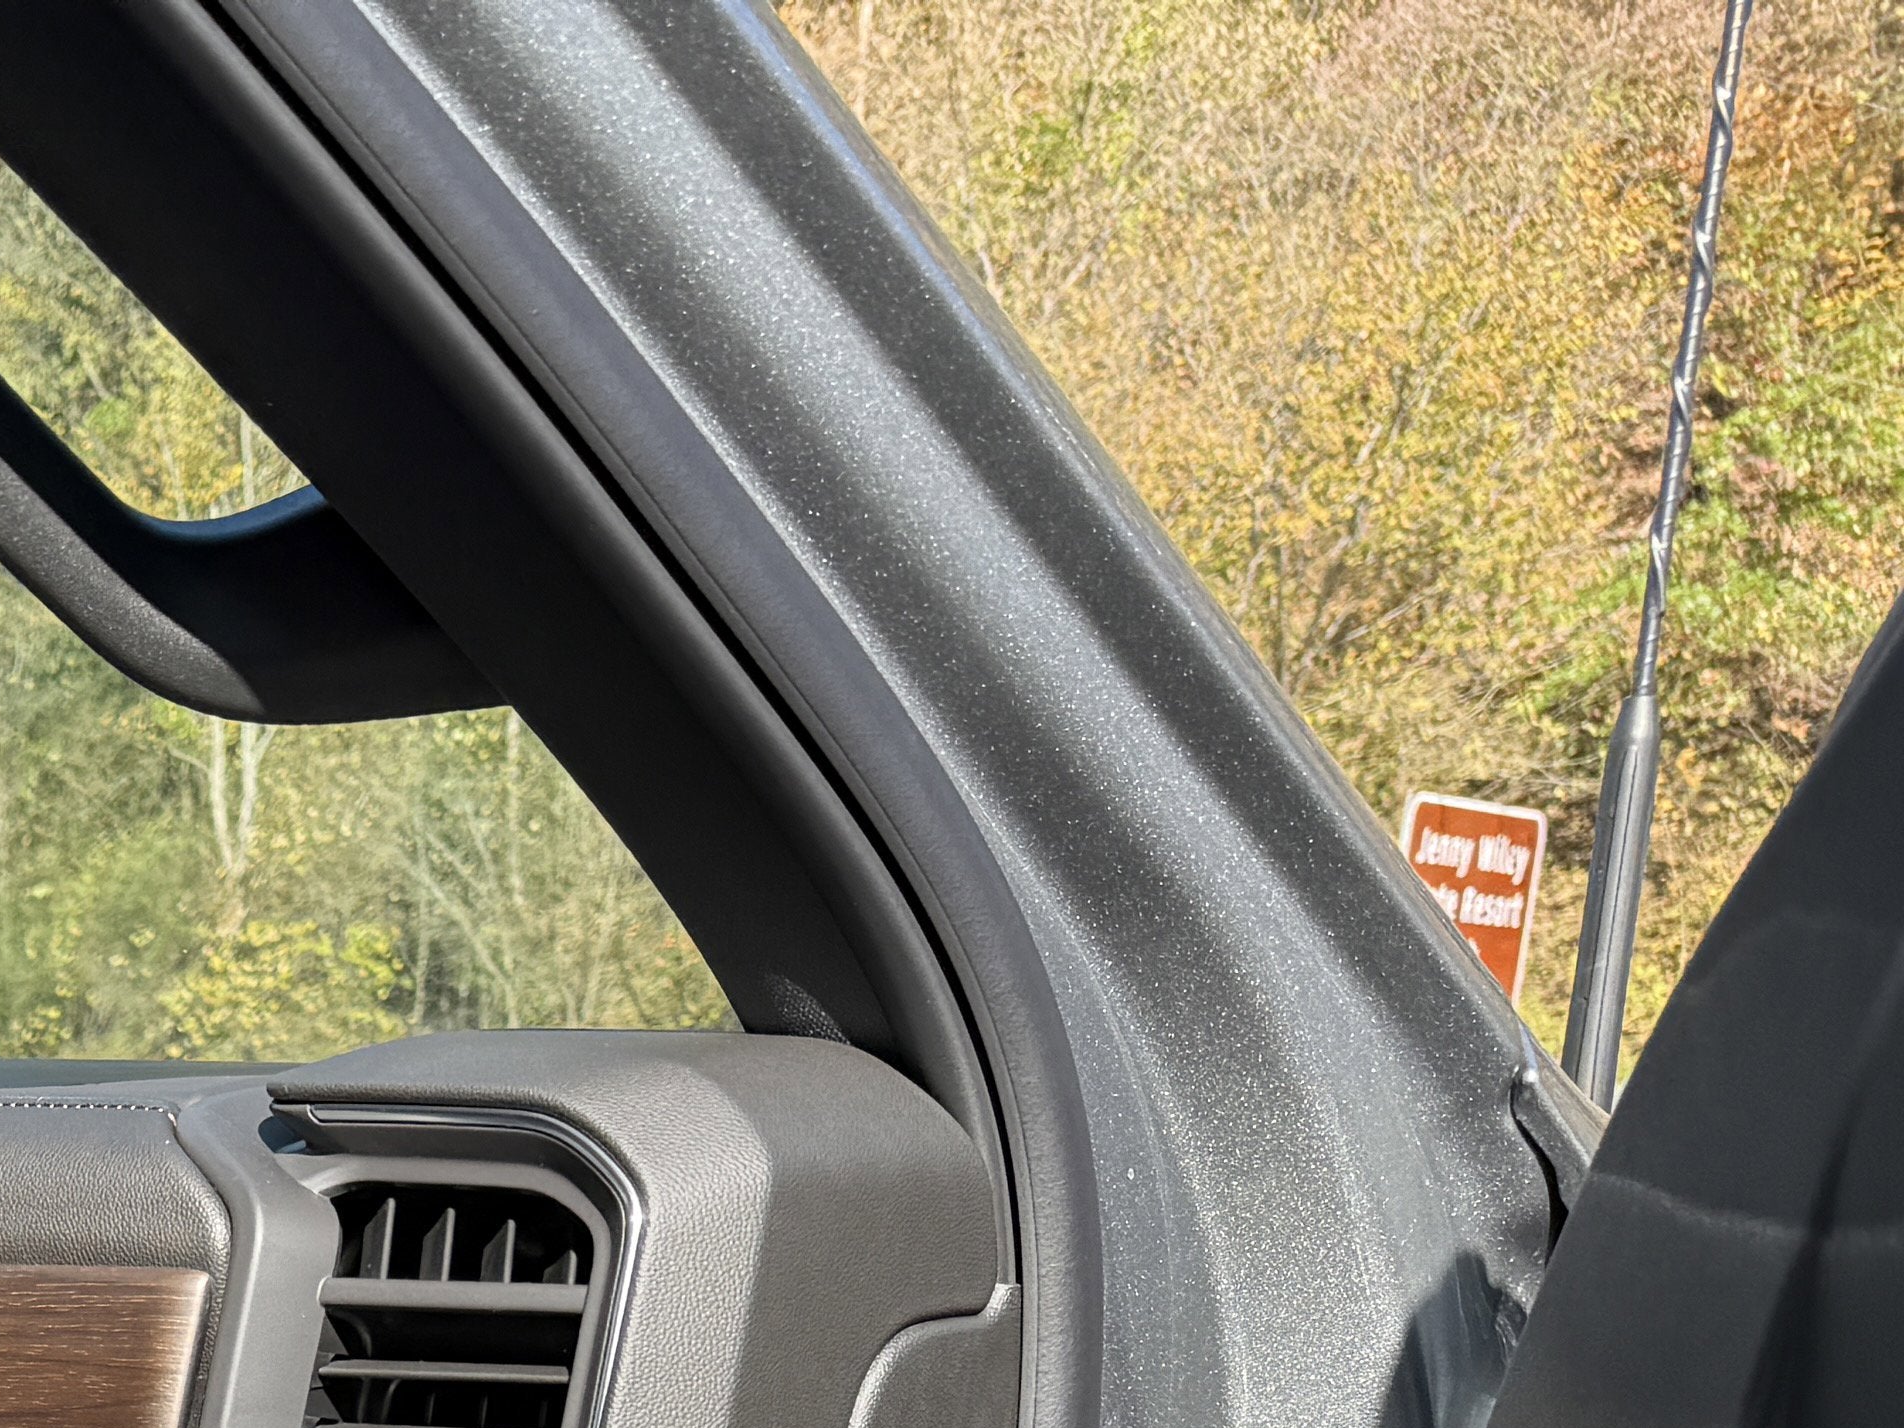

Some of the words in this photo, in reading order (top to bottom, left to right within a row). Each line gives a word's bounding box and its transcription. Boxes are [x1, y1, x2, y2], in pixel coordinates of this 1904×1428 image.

[1415, 826, 1475, 878] Jenny
[1477, 833, 1531, 886] Wiley
[1459, 886, 1524, 929] Resort
